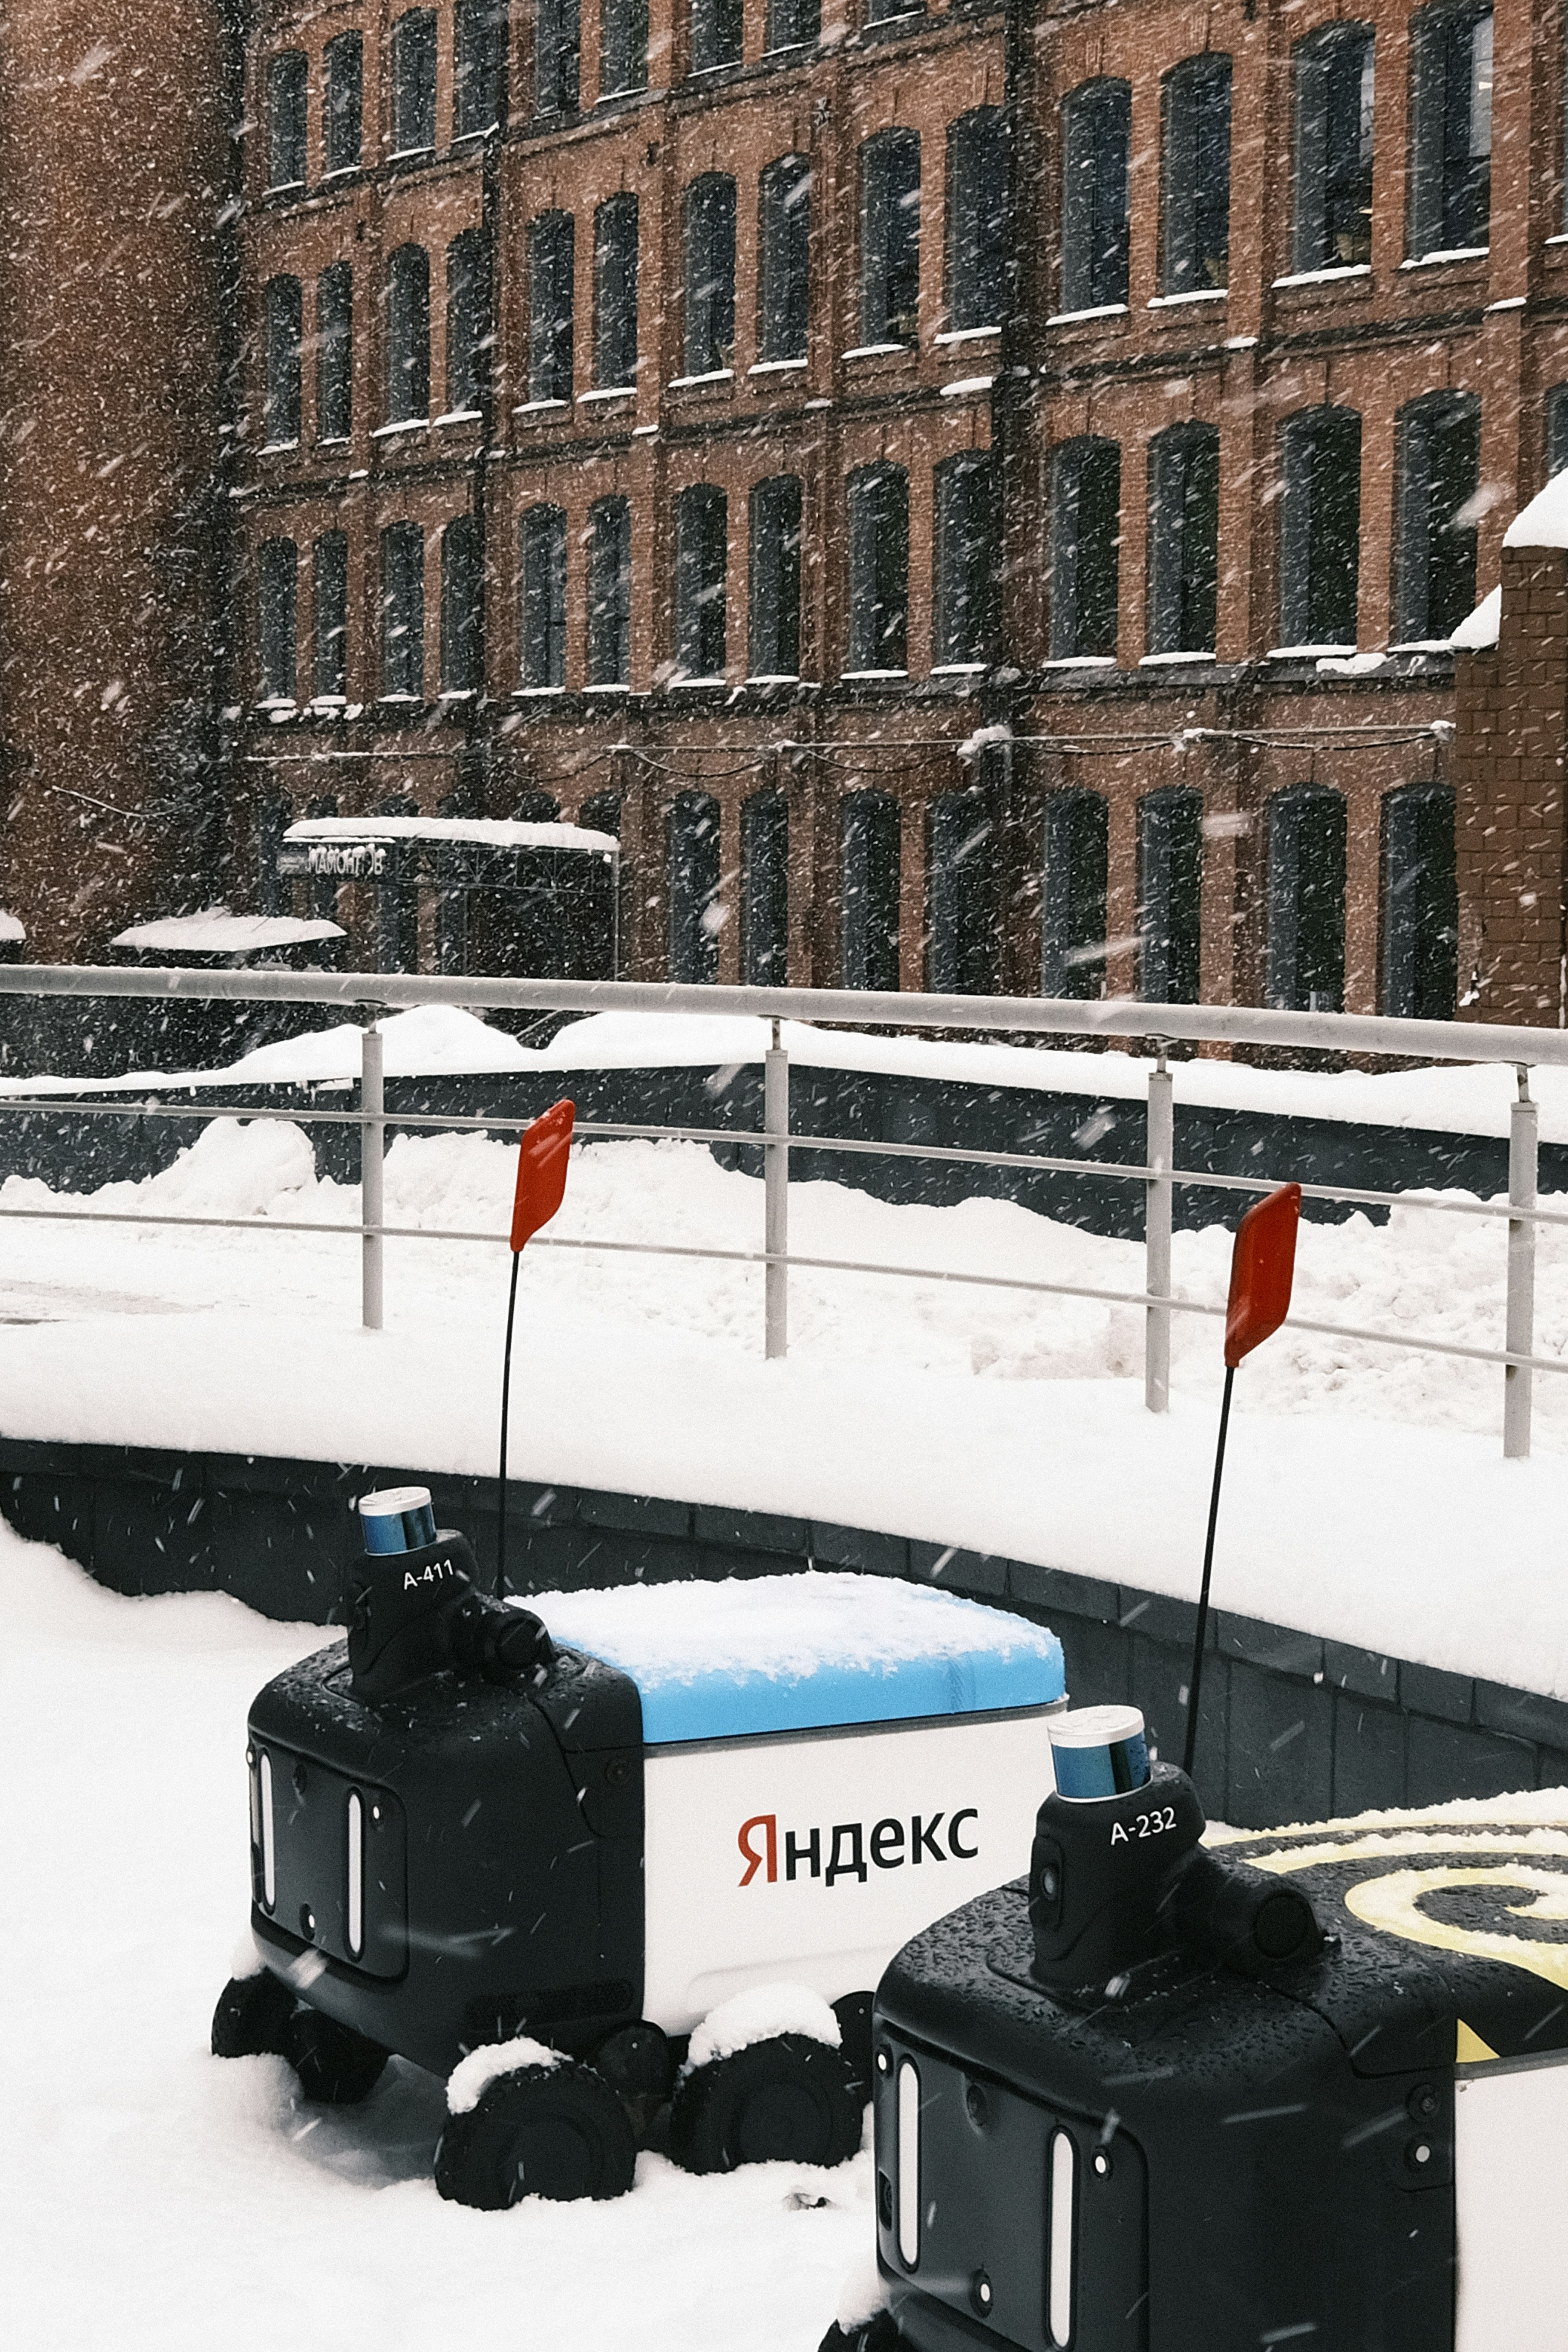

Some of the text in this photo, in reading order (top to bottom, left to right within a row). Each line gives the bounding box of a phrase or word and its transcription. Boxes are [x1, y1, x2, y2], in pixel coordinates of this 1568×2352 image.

[404, 1559, 453, 1590] A-411
[1110, 1807, 1177, 1845] A-232
[738, 1808, 978, 1887] Яндекс
